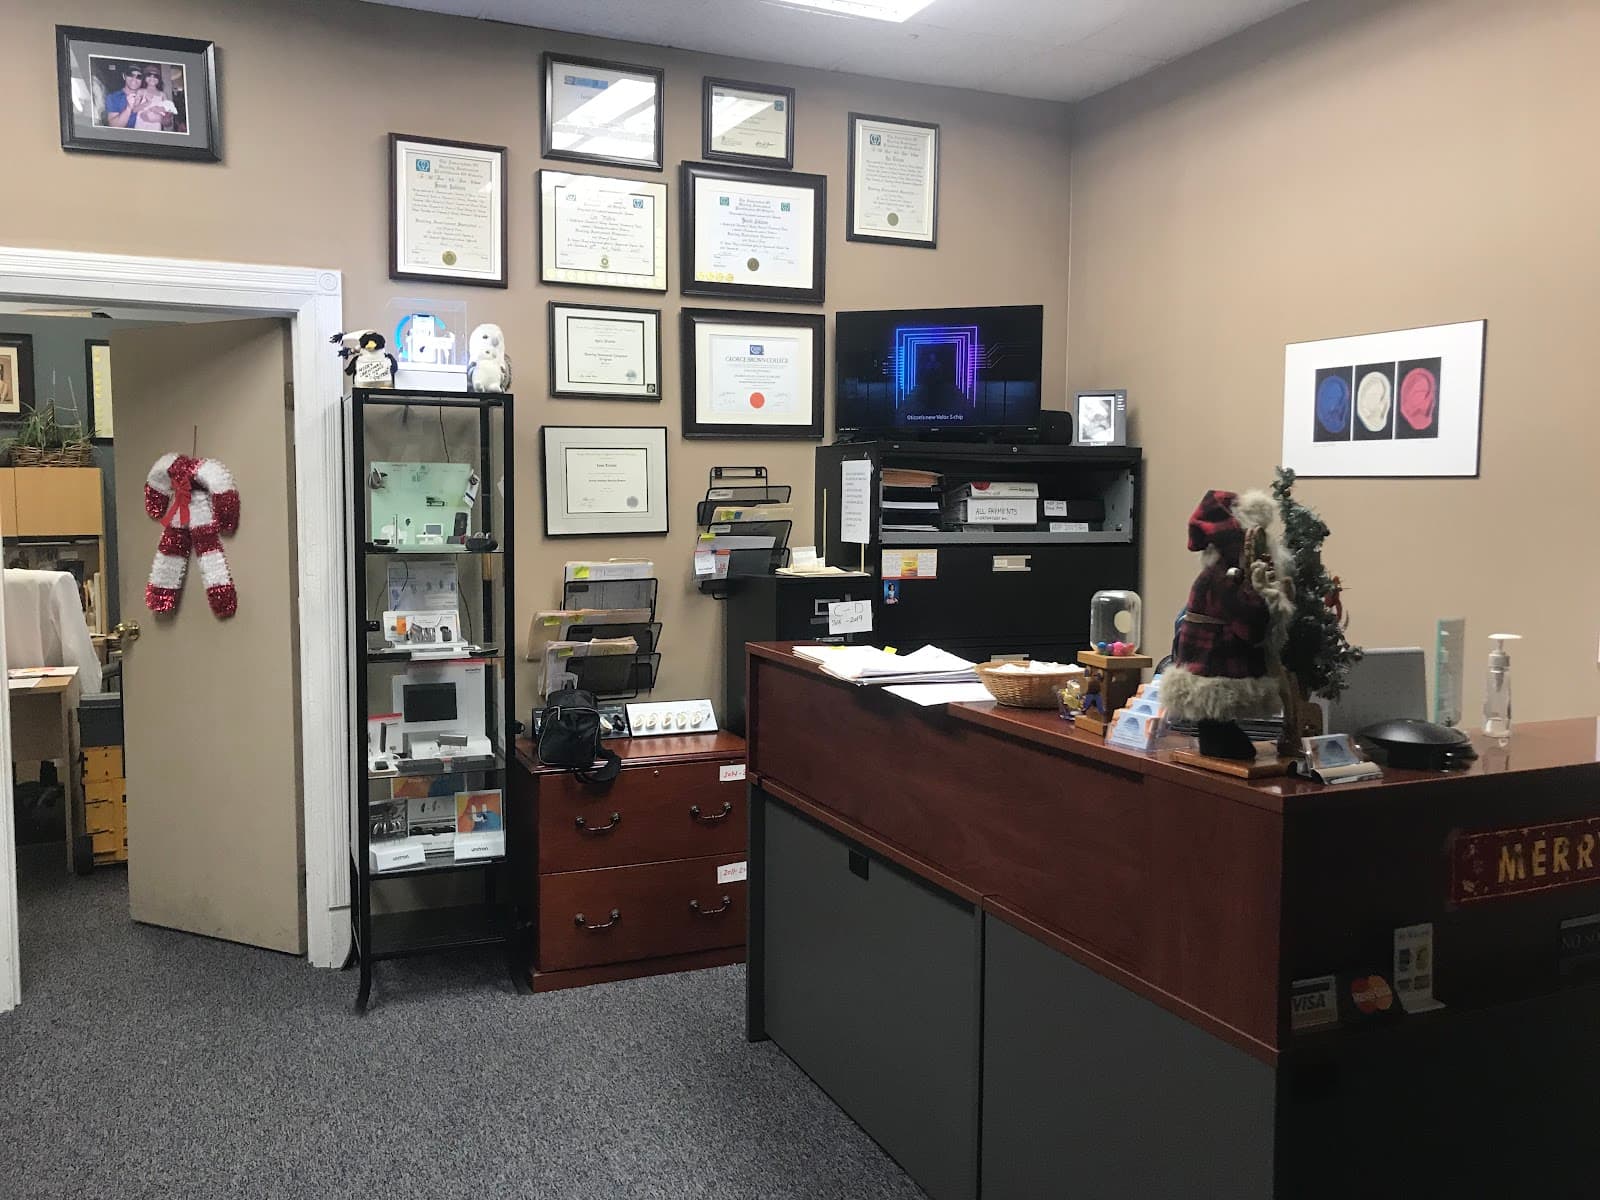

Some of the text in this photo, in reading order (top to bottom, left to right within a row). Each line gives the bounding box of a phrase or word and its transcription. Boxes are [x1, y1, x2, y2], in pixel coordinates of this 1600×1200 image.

[987, 507, 1018, 516] PAYMENTS
[1497, 831, 1600, 883] MERR
[1293, 993, 1327, 1013] VISA
